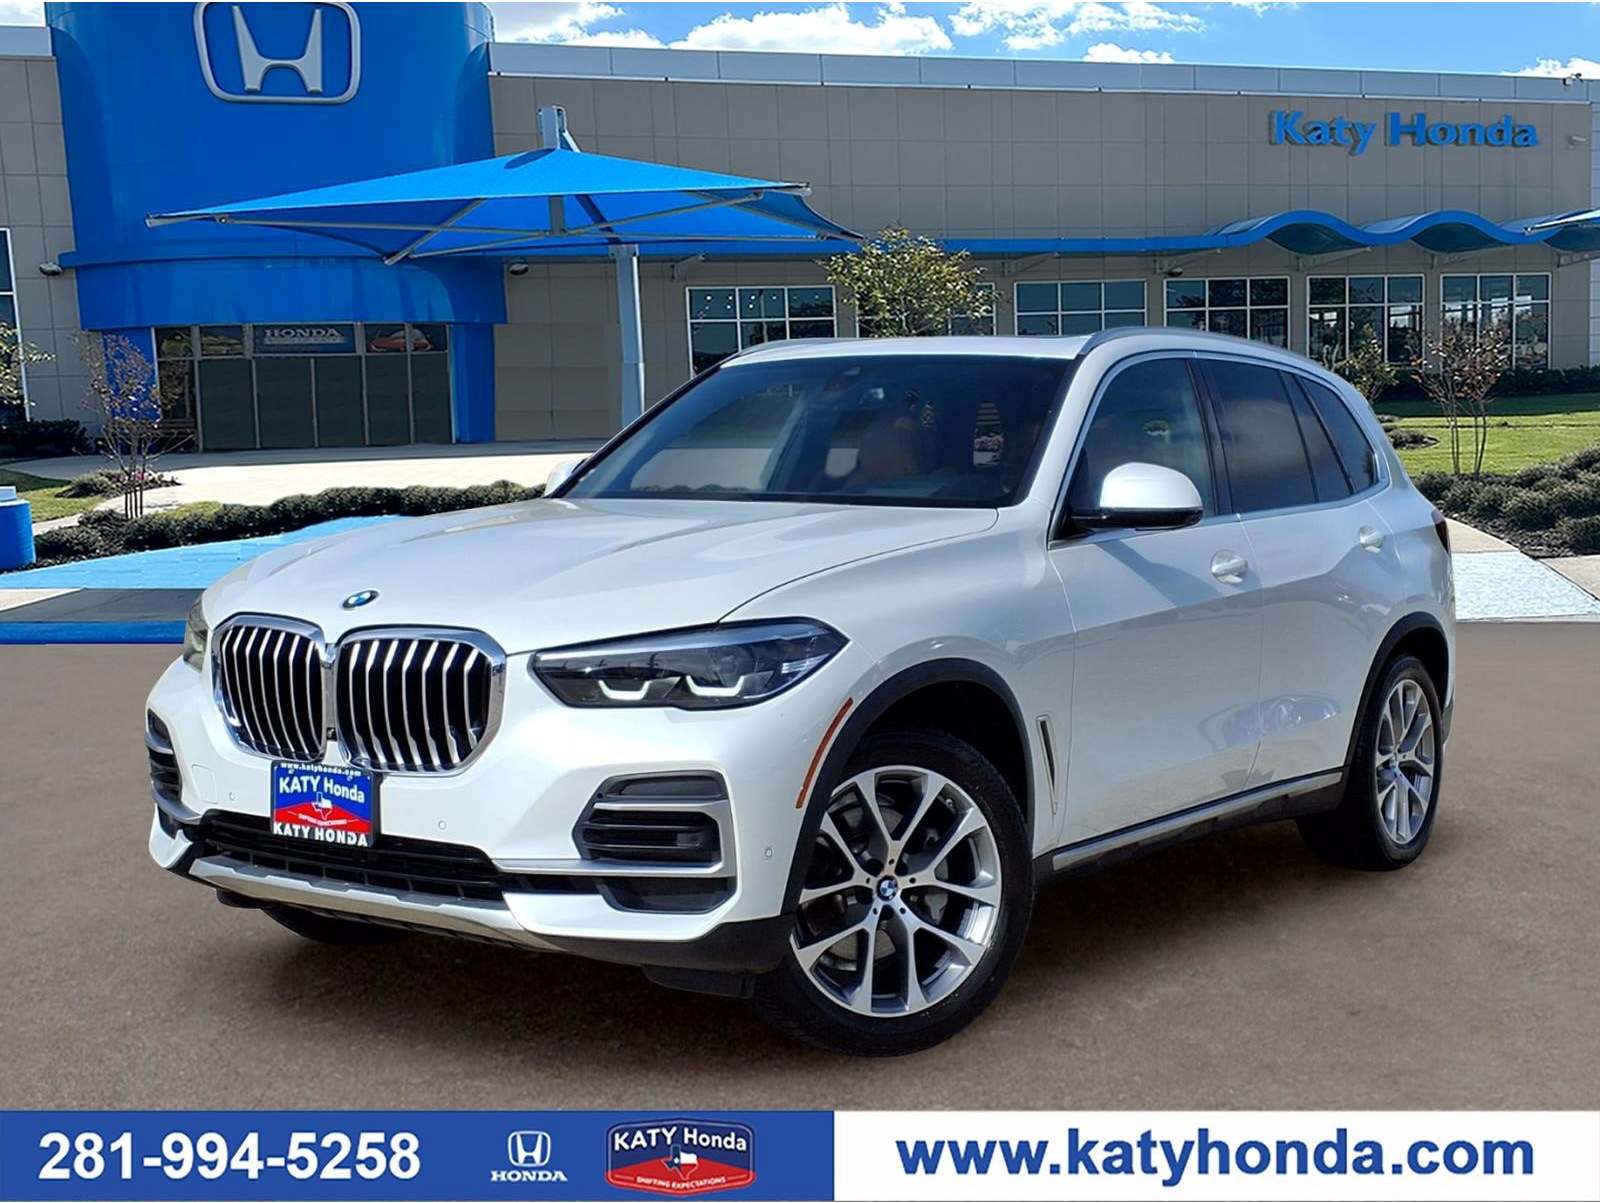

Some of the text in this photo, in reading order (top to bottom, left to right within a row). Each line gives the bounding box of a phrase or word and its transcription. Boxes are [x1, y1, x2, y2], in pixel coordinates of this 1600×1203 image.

[1268, 110, 1539, 156] Katy Honda
[263, 327, 342, 338] HONDA
[279, 775, 365, 804] KATY Honda
[273, 822, 368, 848] KATY HONDA
